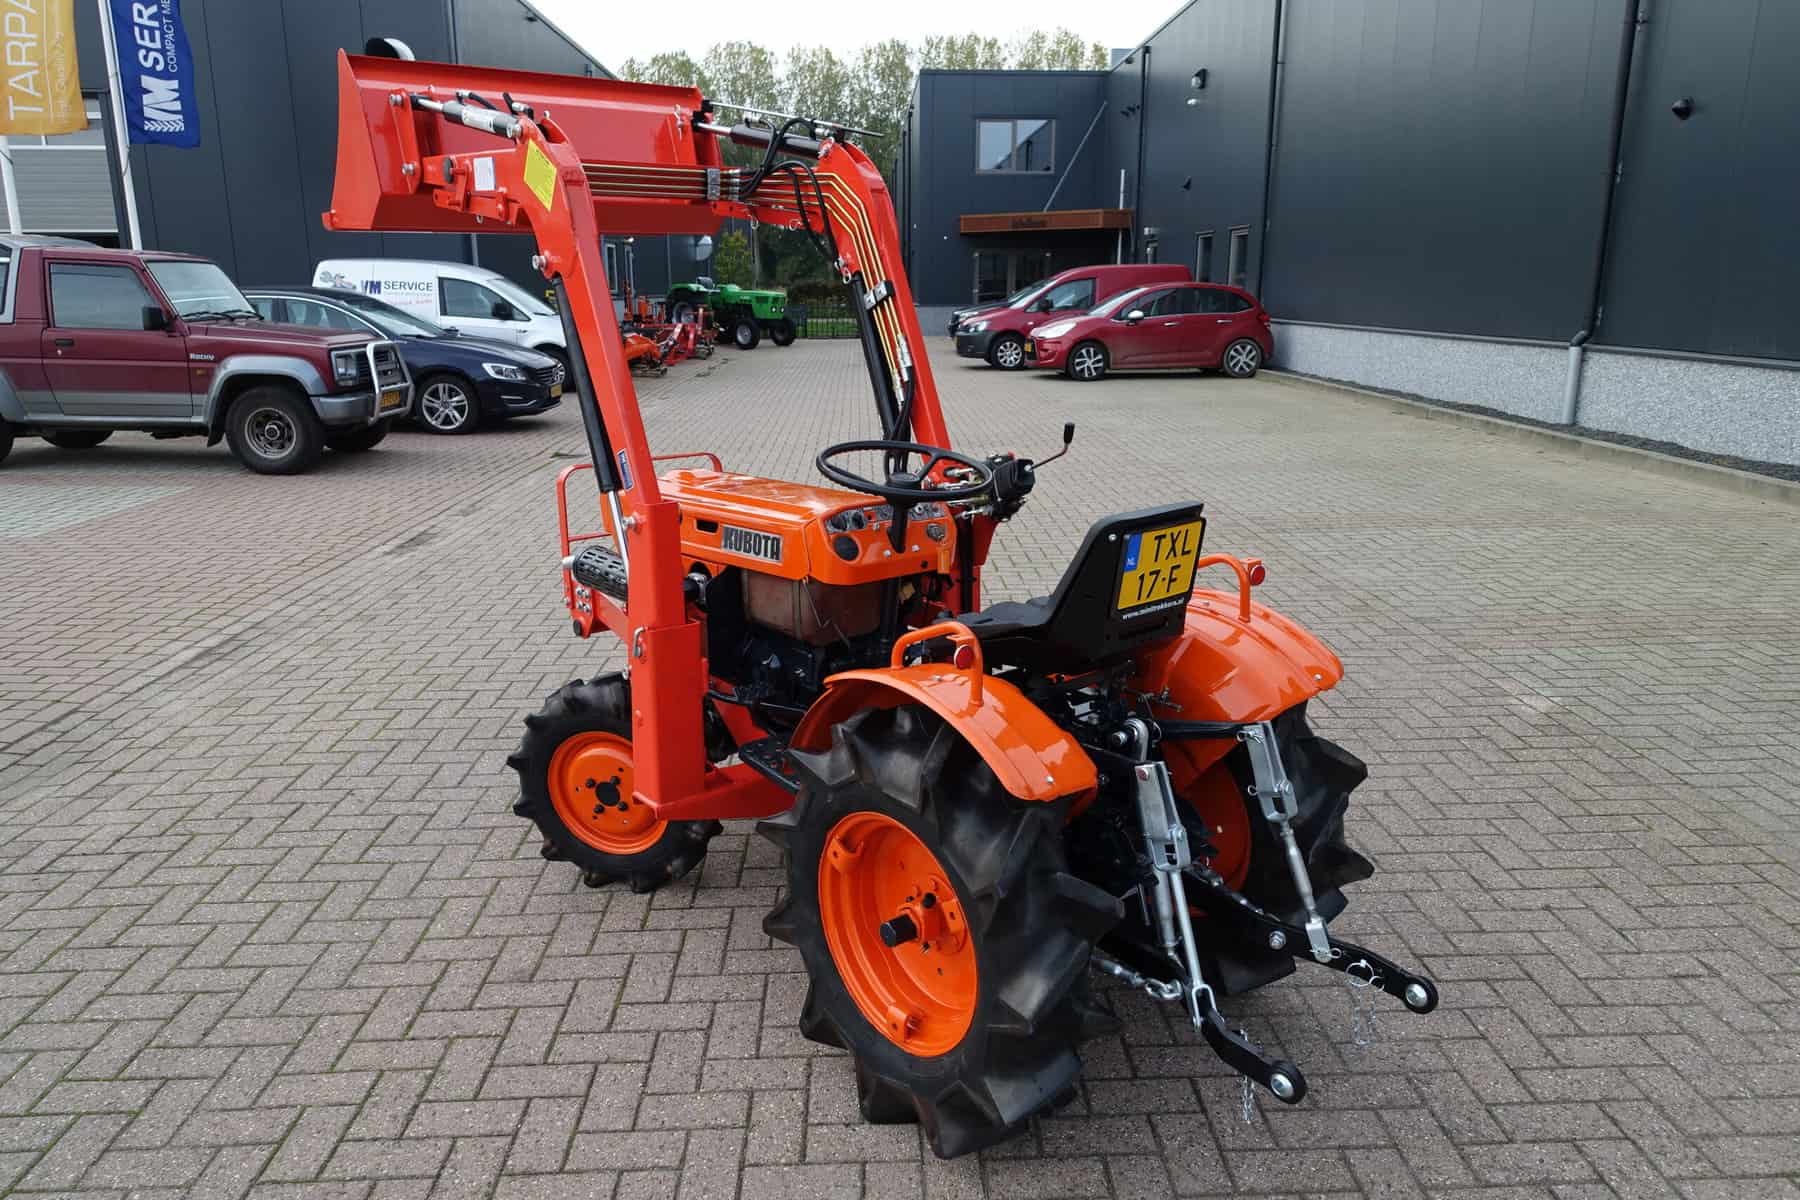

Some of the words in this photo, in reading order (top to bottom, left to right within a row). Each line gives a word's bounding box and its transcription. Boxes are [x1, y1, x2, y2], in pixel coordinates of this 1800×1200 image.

[163, 15, 178, 73] COMPACT
[383, 279, 433, 292] SERVICE
[723, 526, 781, 561] KUBOTA
[1154, 528, 1192, 563] TXL
